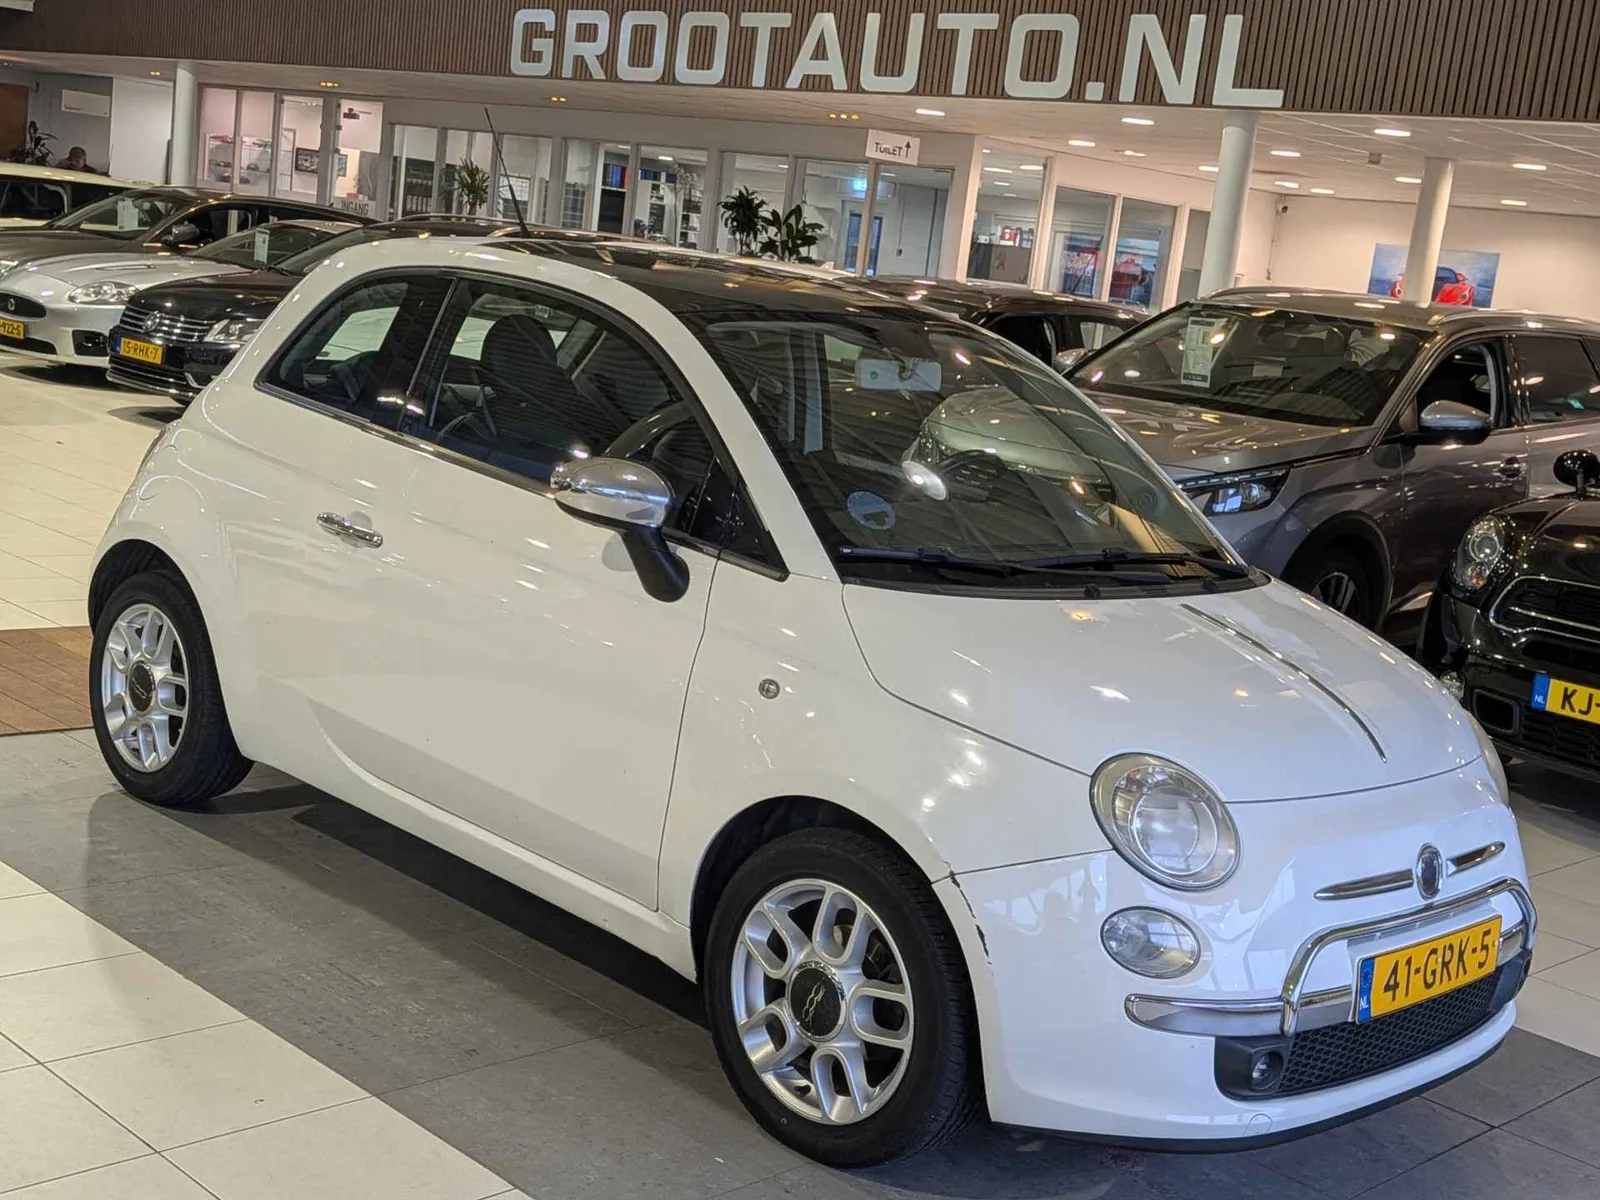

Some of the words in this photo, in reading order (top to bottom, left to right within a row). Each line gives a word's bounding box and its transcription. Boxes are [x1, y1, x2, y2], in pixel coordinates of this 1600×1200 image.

[510, 8, 1285, 108] GROOTAUTO.NL
[874, 141, 903, 157] TOILET
[341, 200, 369, 215] INGANG
[123, 340, 160, 360] 15-RHK-7
[1534, 693, 1545, 704] NL
[1359, 995, 1369, 1011] NL
[1383, 928, 1492, 1002] 41-GRK-5
